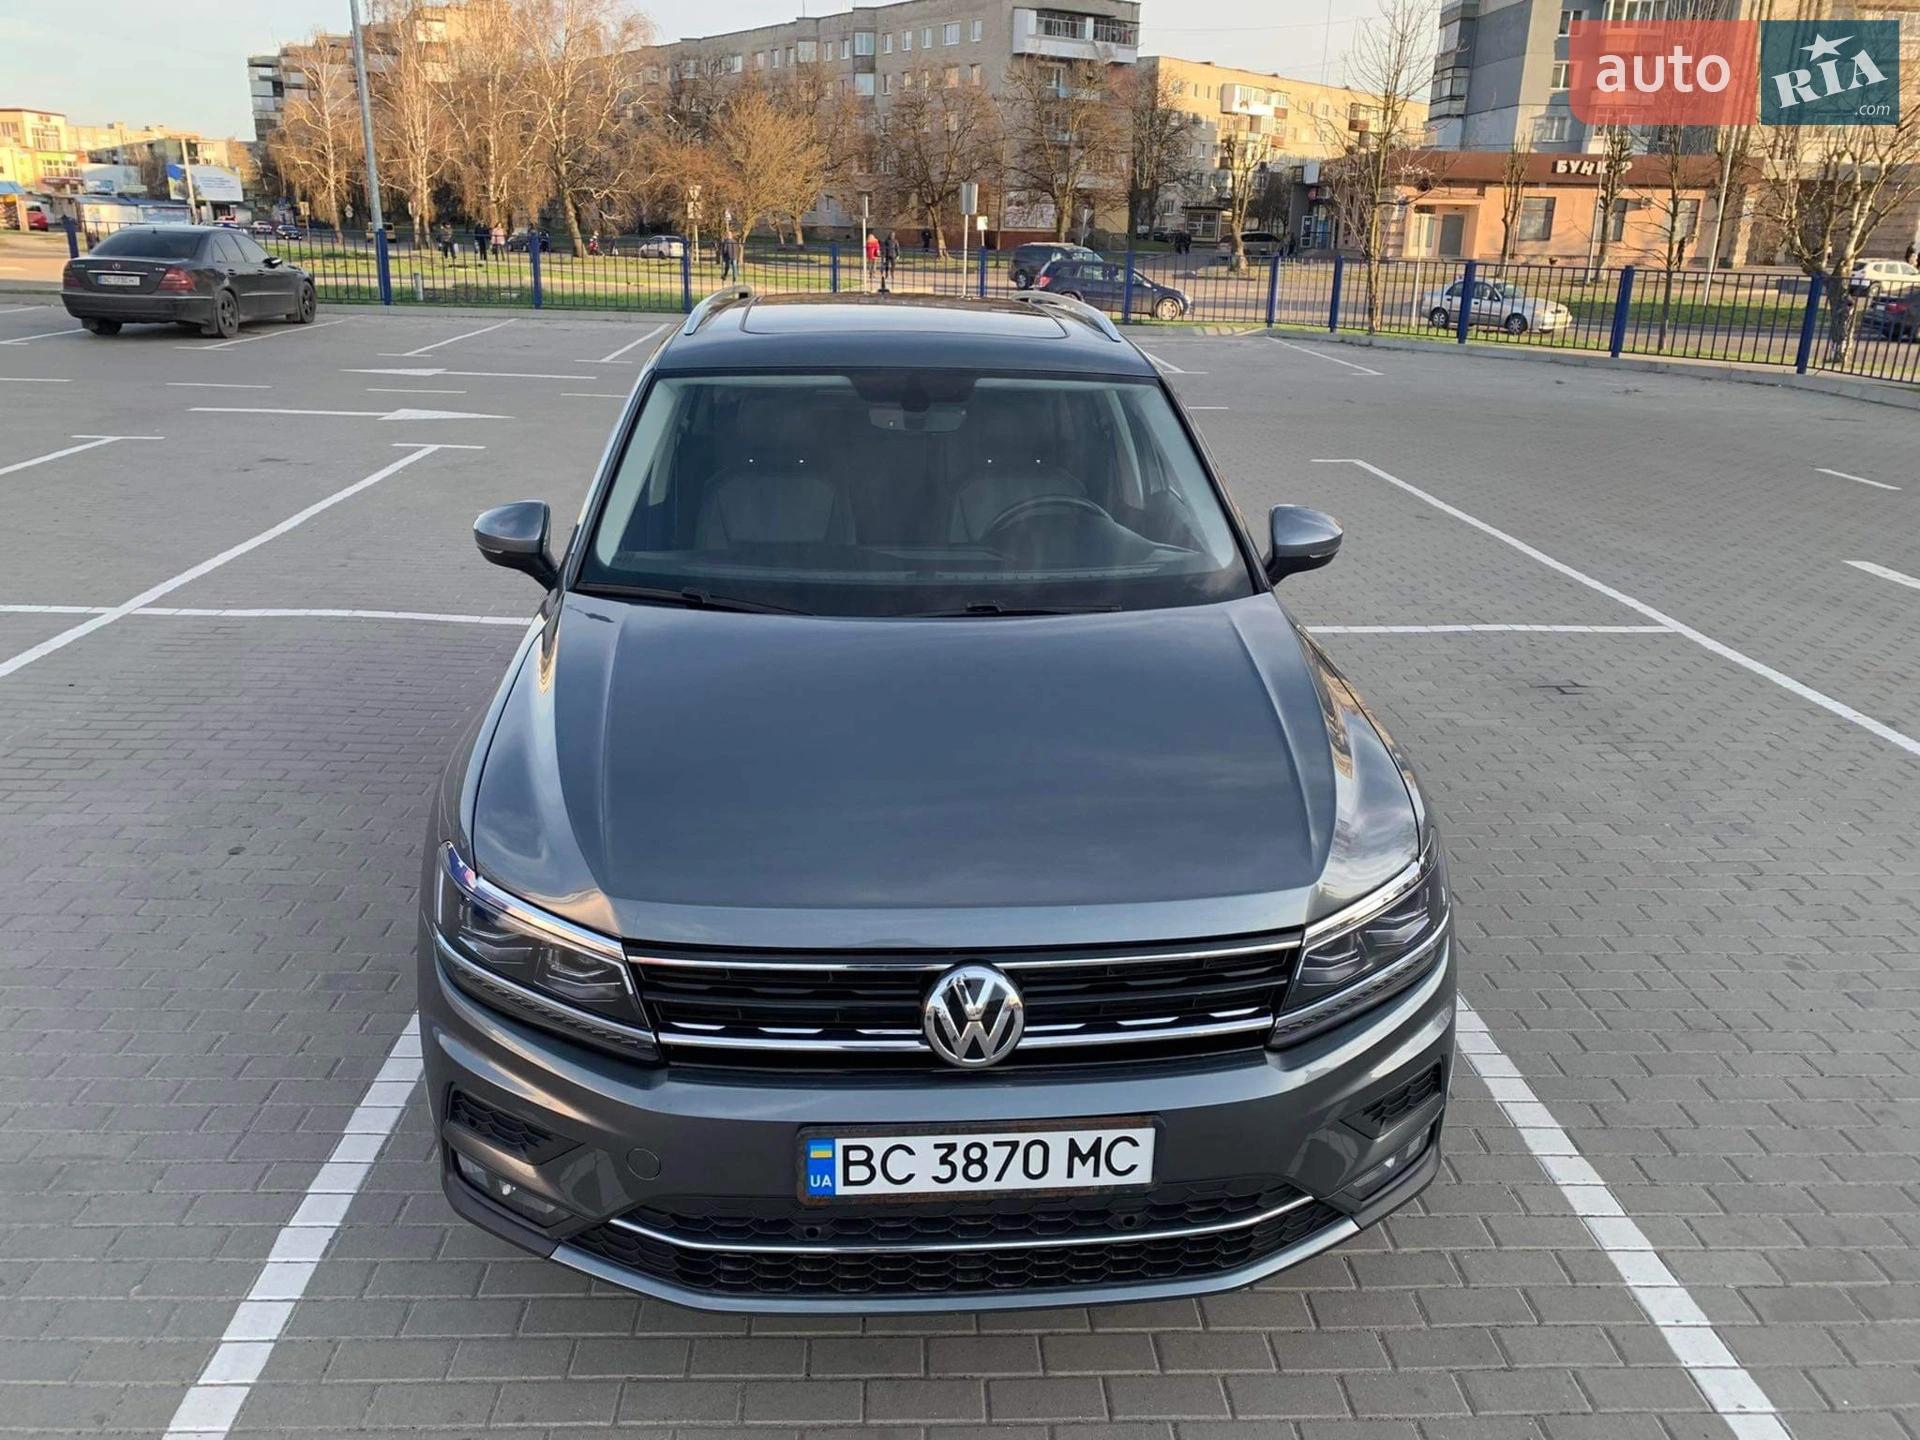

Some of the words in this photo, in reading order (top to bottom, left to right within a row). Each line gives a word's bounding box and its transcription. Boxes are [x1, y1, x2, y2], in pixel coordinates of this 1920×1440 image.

[1555, 160, 1633, 176] БУНКР
[842, 1144, 916, 1187] BC
[931, 1139, 1050, 1184] 3870
[1066, 1135, 1141, 1179] MC
[810, 1174, 832, 1188] UA
